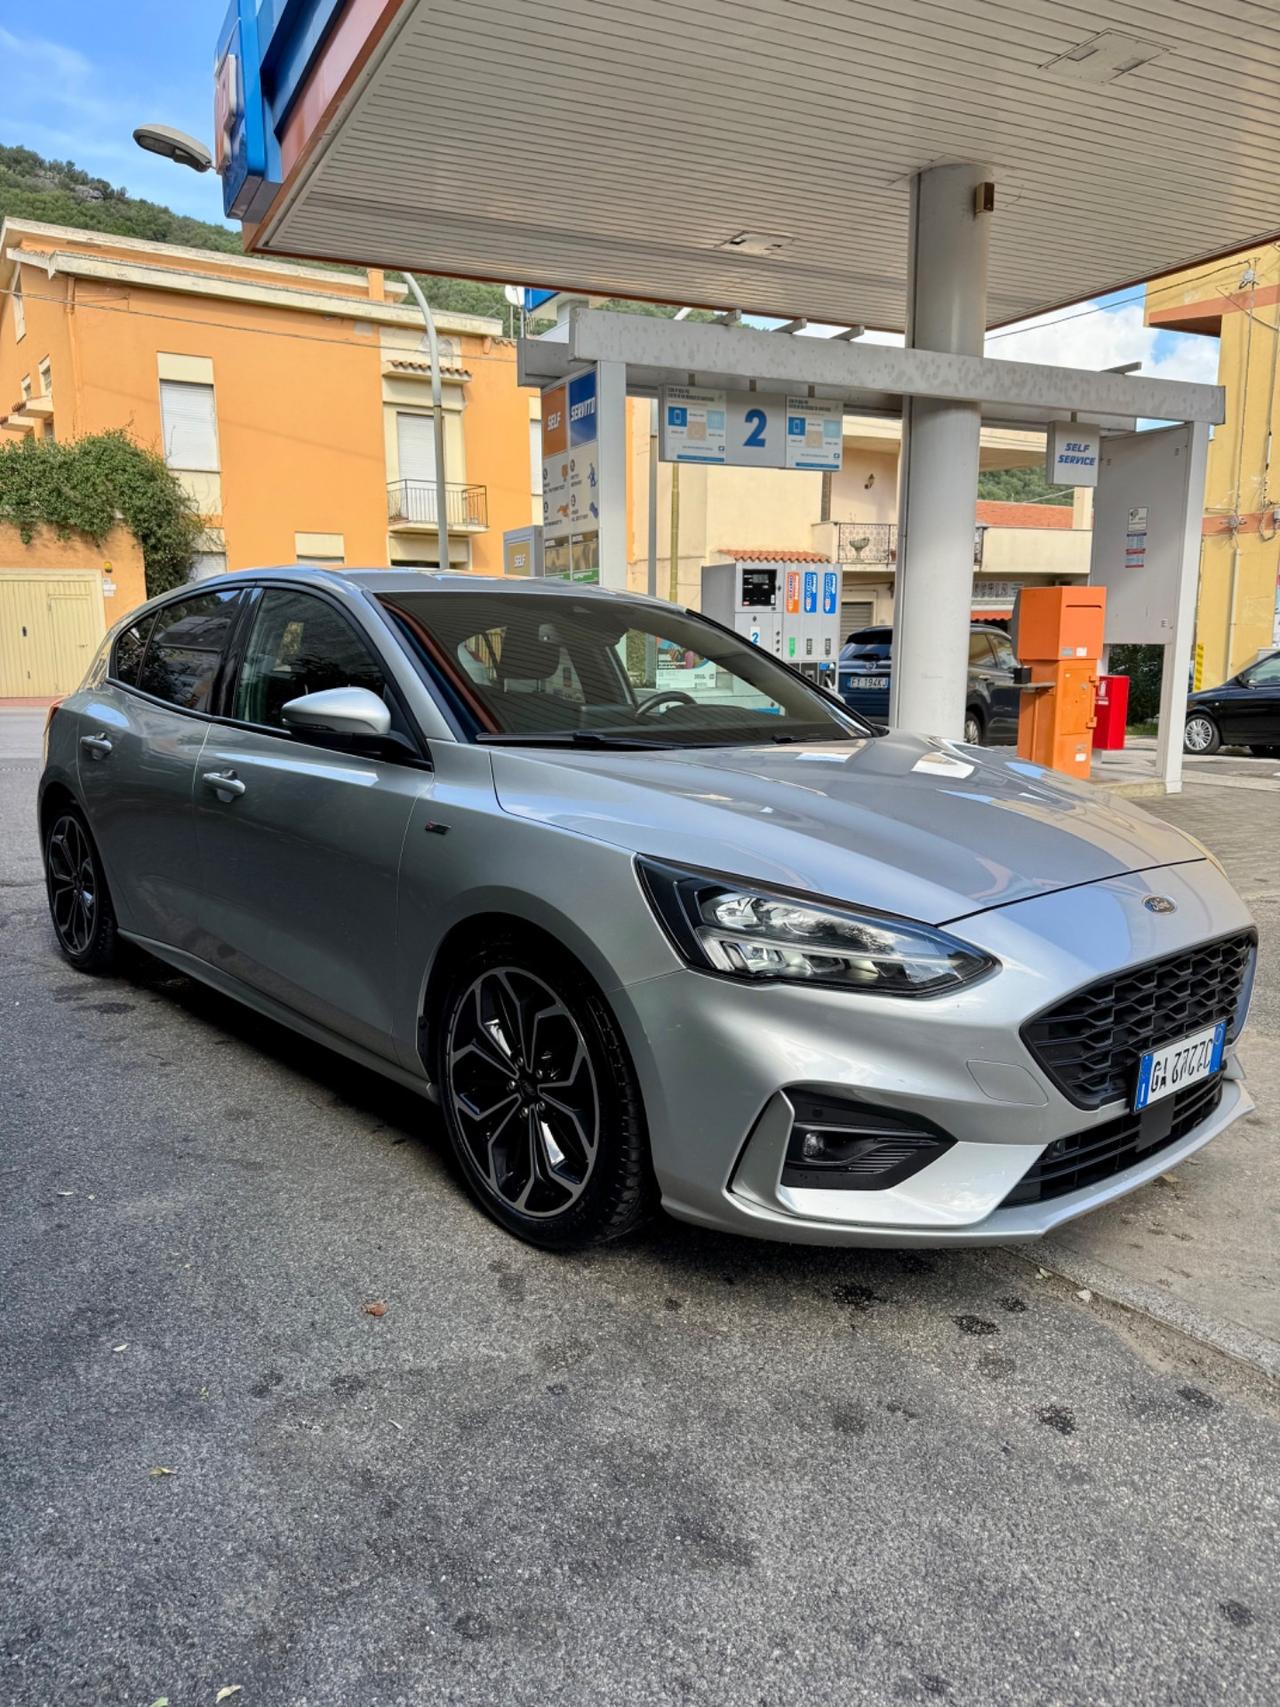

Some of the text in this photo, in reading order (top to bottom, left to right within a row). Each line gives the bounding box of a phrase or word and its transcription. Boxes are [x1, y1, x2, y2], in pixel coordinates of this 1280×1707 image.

[547, 412, 561, 431] SELF
[742, 408, 767, 447] 2
[1064, 442, 1090, 453] SELF
[1058, 454, 1096, 466] SERVICE
[751, 632, 759, 645] 2
